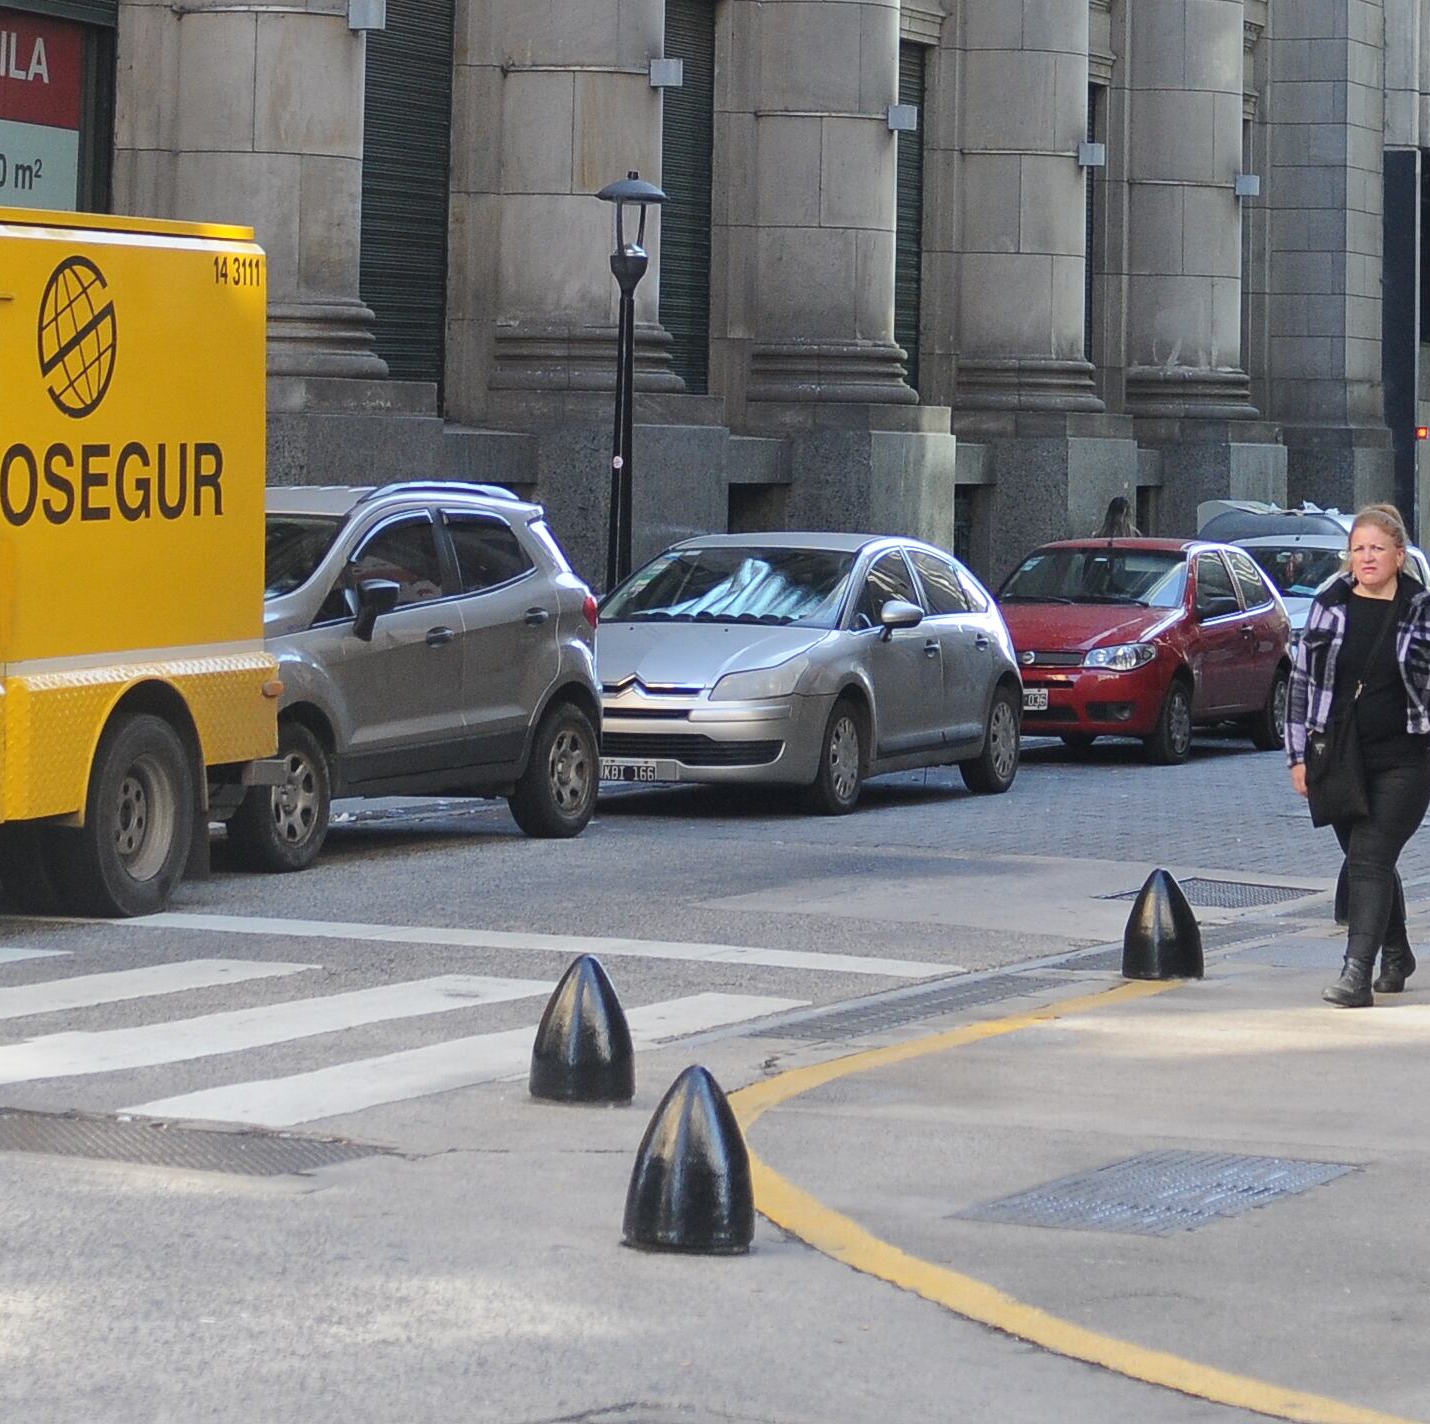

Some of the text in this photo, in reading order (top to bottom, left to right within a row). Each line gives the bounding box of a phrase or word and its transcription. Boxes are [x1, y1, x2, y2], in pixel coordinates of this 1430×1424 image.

[214, 256, 260, 287] 14 3111
[603, 766, 655, 781] KBI 166
